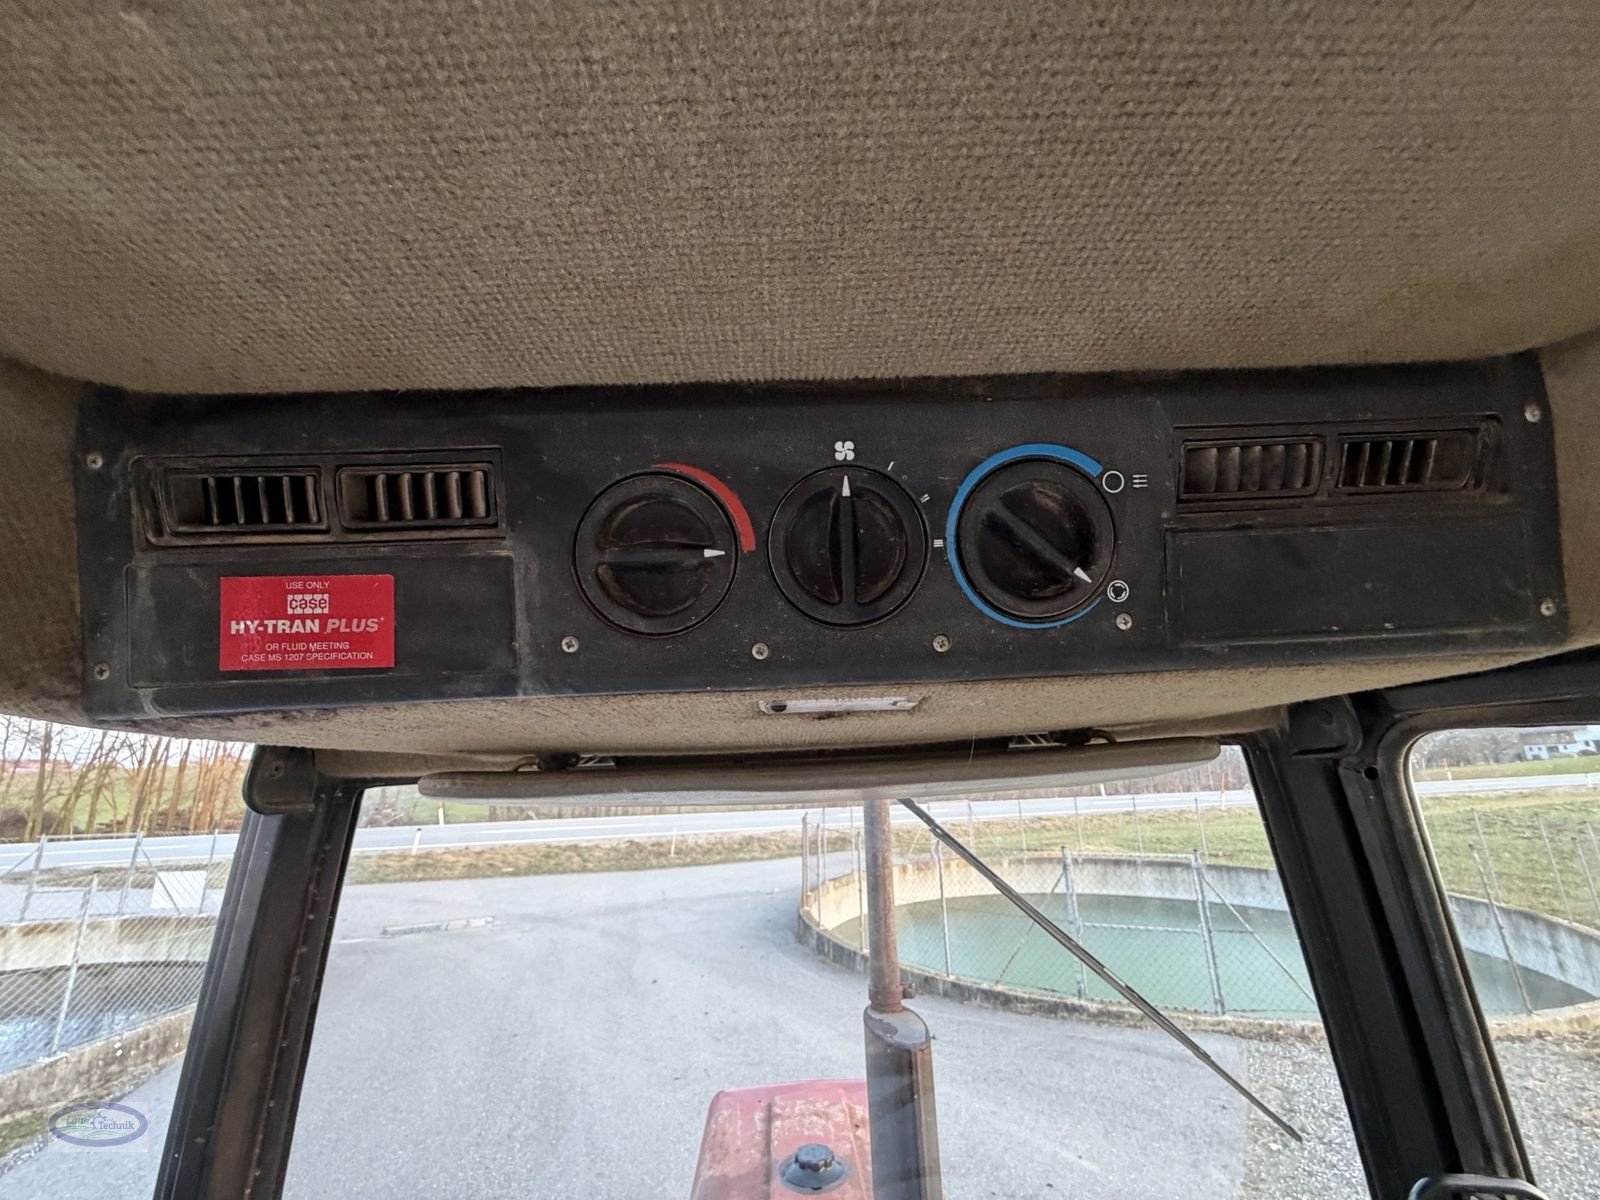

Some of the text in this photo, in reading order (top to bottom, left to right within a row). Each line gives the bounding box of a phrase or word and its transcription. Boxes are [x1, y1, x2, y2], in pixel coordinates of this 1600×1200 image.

[286, 580, 330, 589] USE ONLY
[230, 618, 380, 635] HY-TRAN PLUS
[265, 641, 350, 651] OR FLUID MEETING
[241, 651, 374, 662] CASE MS 1207 SPECIFICATION
